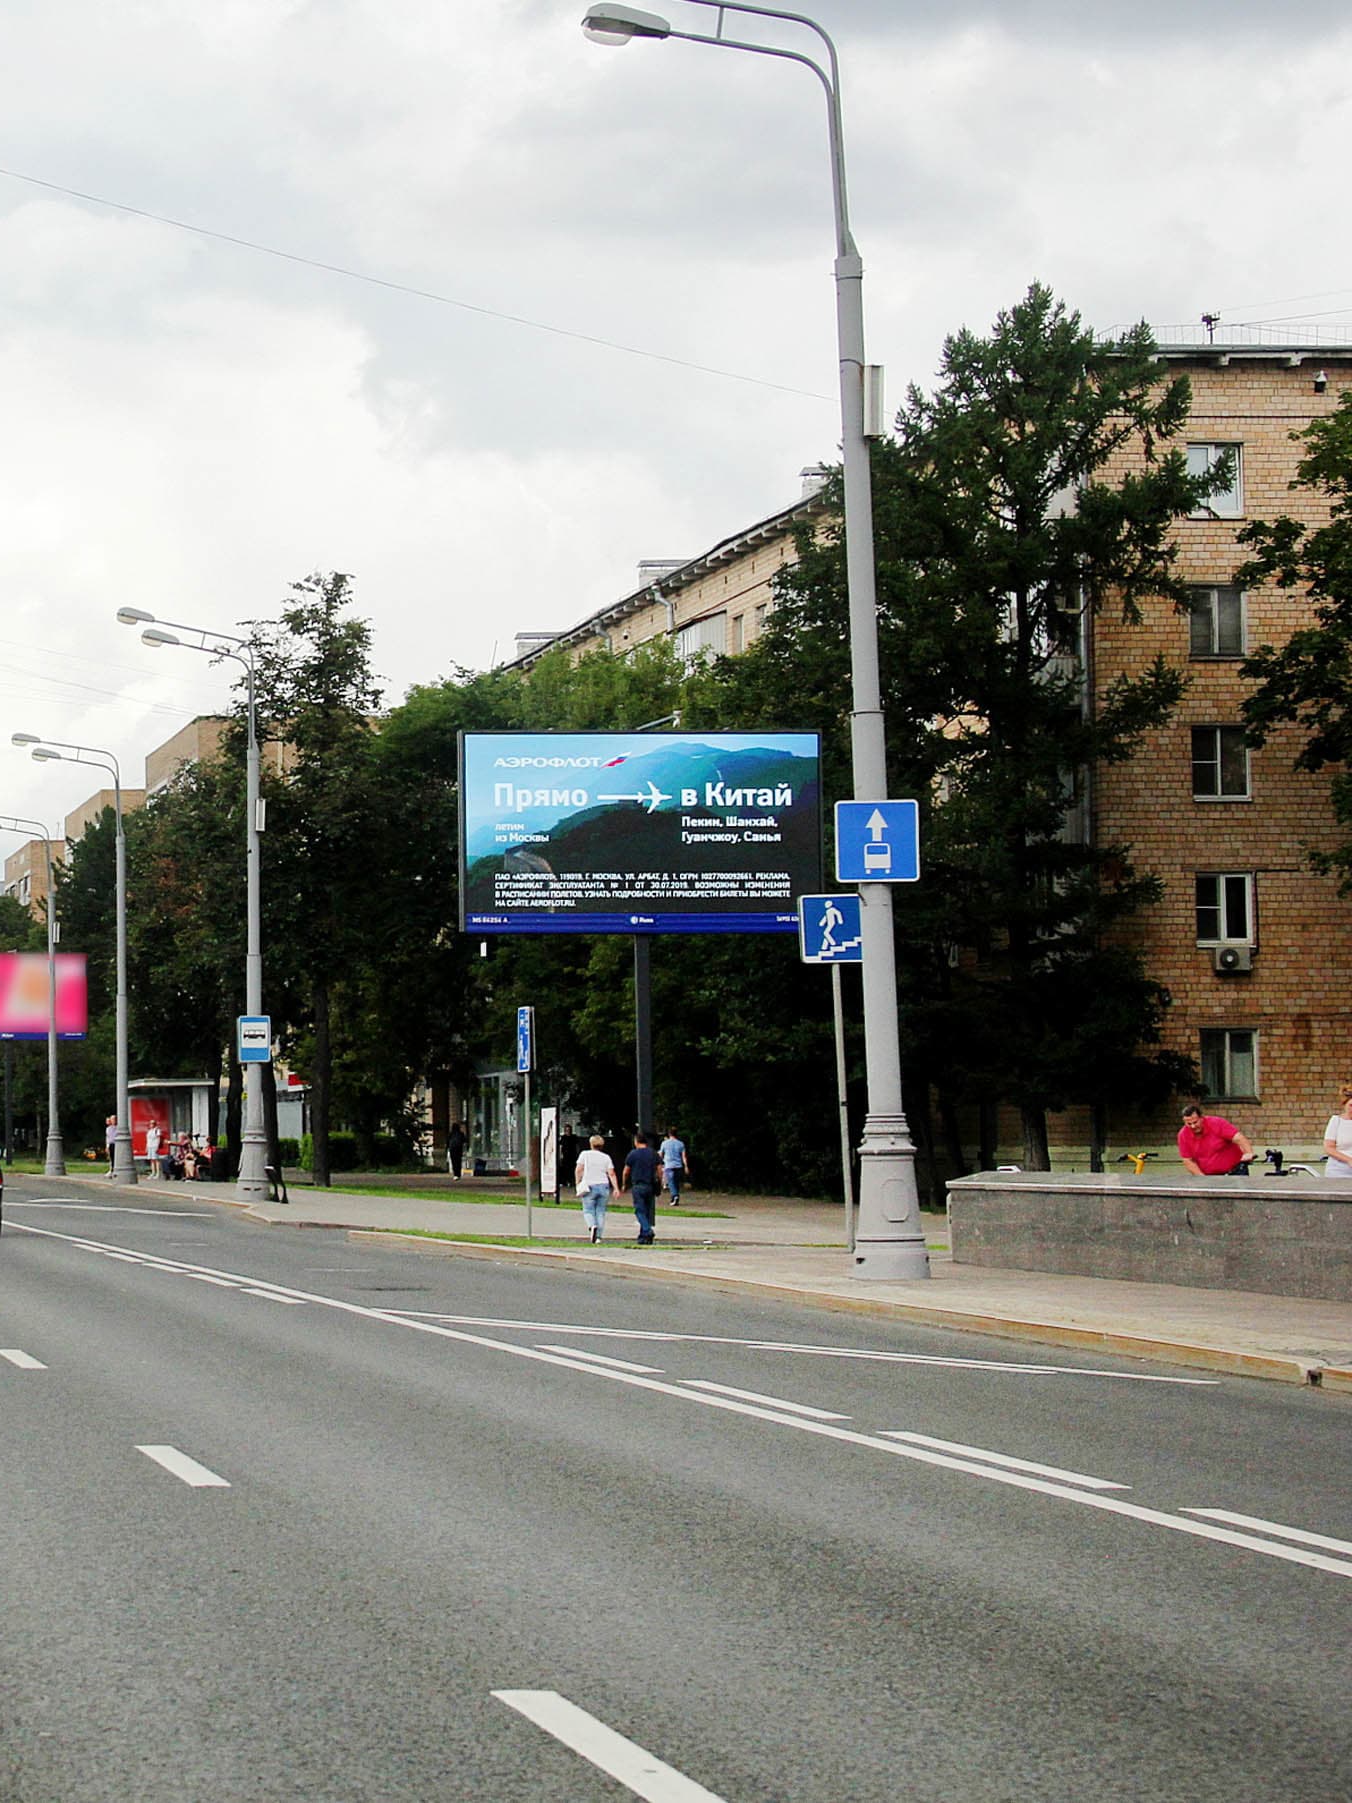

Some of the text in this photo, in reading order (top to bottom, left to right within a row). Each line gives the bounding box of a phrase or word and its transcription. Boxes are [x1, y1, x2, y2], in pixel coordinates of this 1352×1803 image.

[494, 757, 602, 768] АЭРОФЛОТ
[494, 782, 793, 812] Прямо в Китай
[681, 816, 778, 828] Пекин, Шанхай,
[495, 823, 525, 831] летим
[495, 833, 550, 842] из Москвы
[681, 831, 782, 844] Гуанчжоу, Санья
[495, 872, 511, 880] ПАО
[634, 882, 645, 890] ОТ
[612, 890, 665, 898] ПОДРОБНОСТИ
